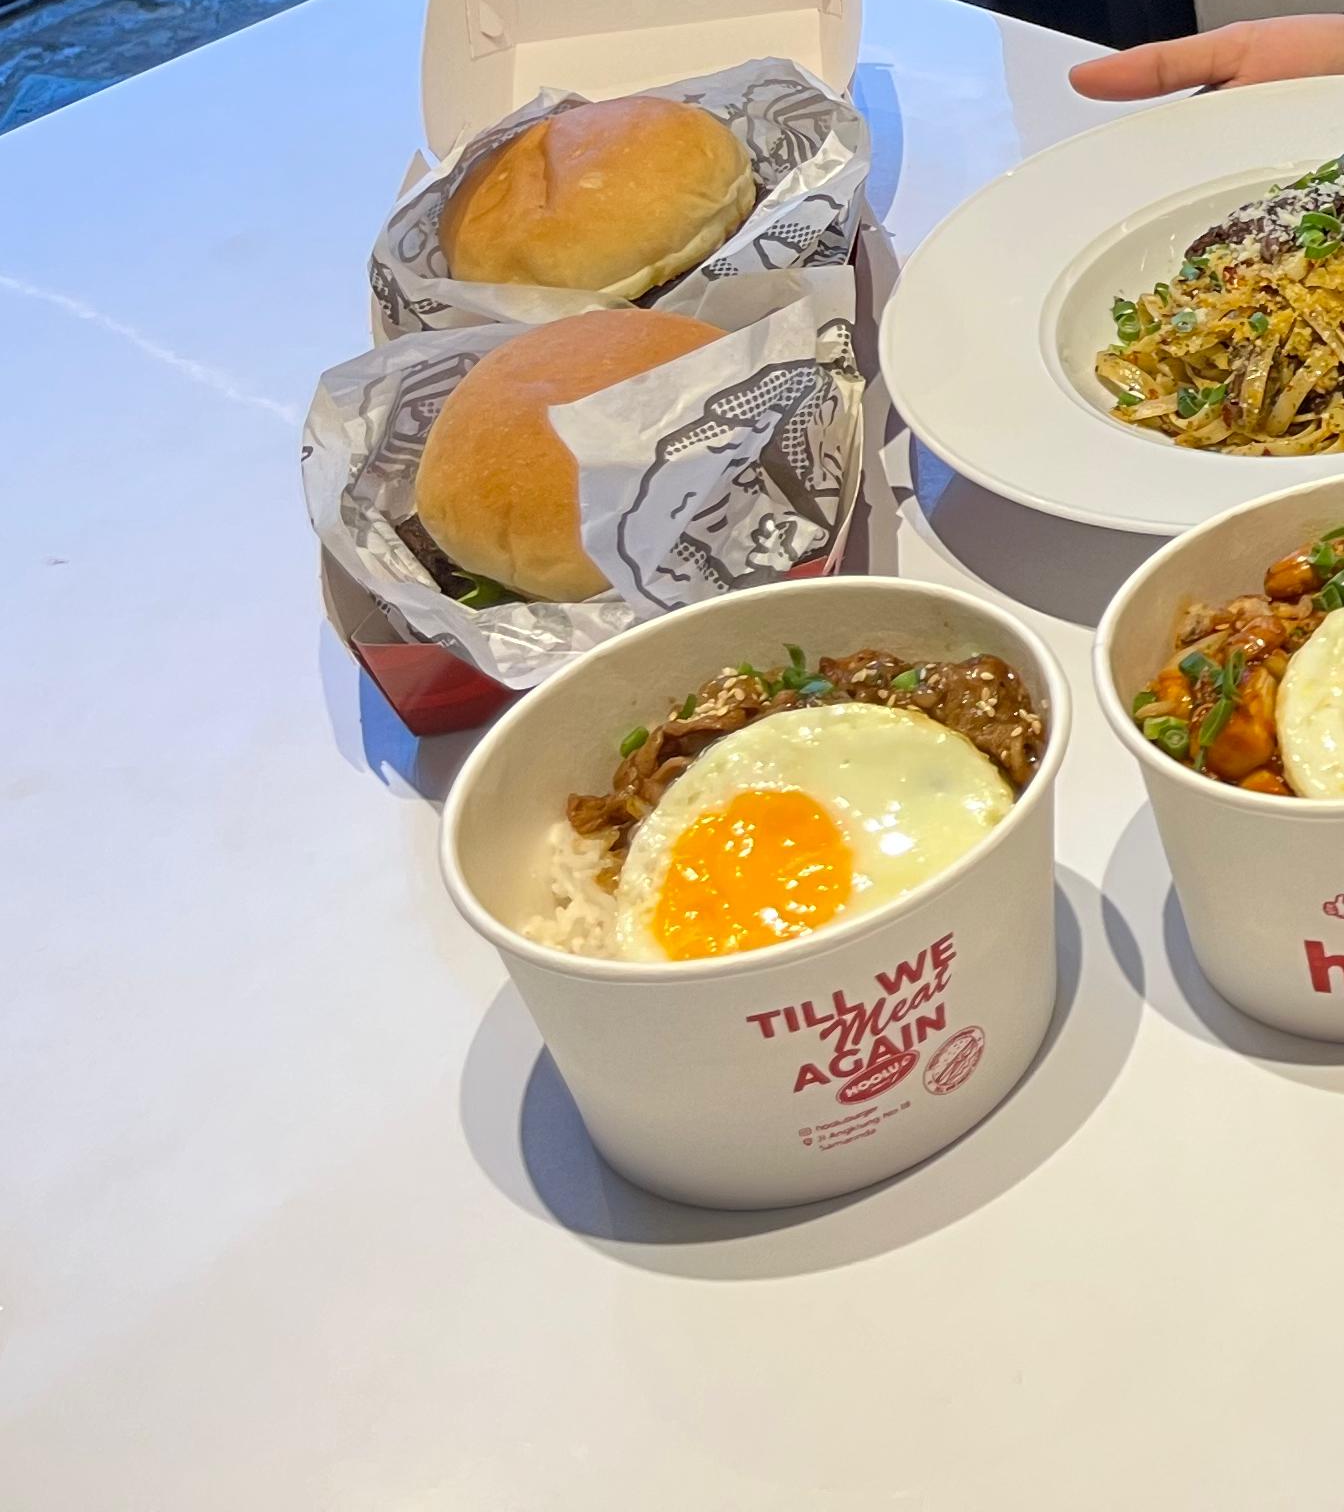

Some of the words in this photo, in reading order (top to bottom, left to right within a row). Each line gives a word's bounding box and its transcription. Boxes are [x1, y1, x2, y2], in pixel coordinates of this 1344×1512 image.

[746, 990, 864, 1038] TILL
[874, 932, 956, 996] WE
[819, 963, 952, 1053] Meat
[793, 1002, 946, 1093] AGAIN
